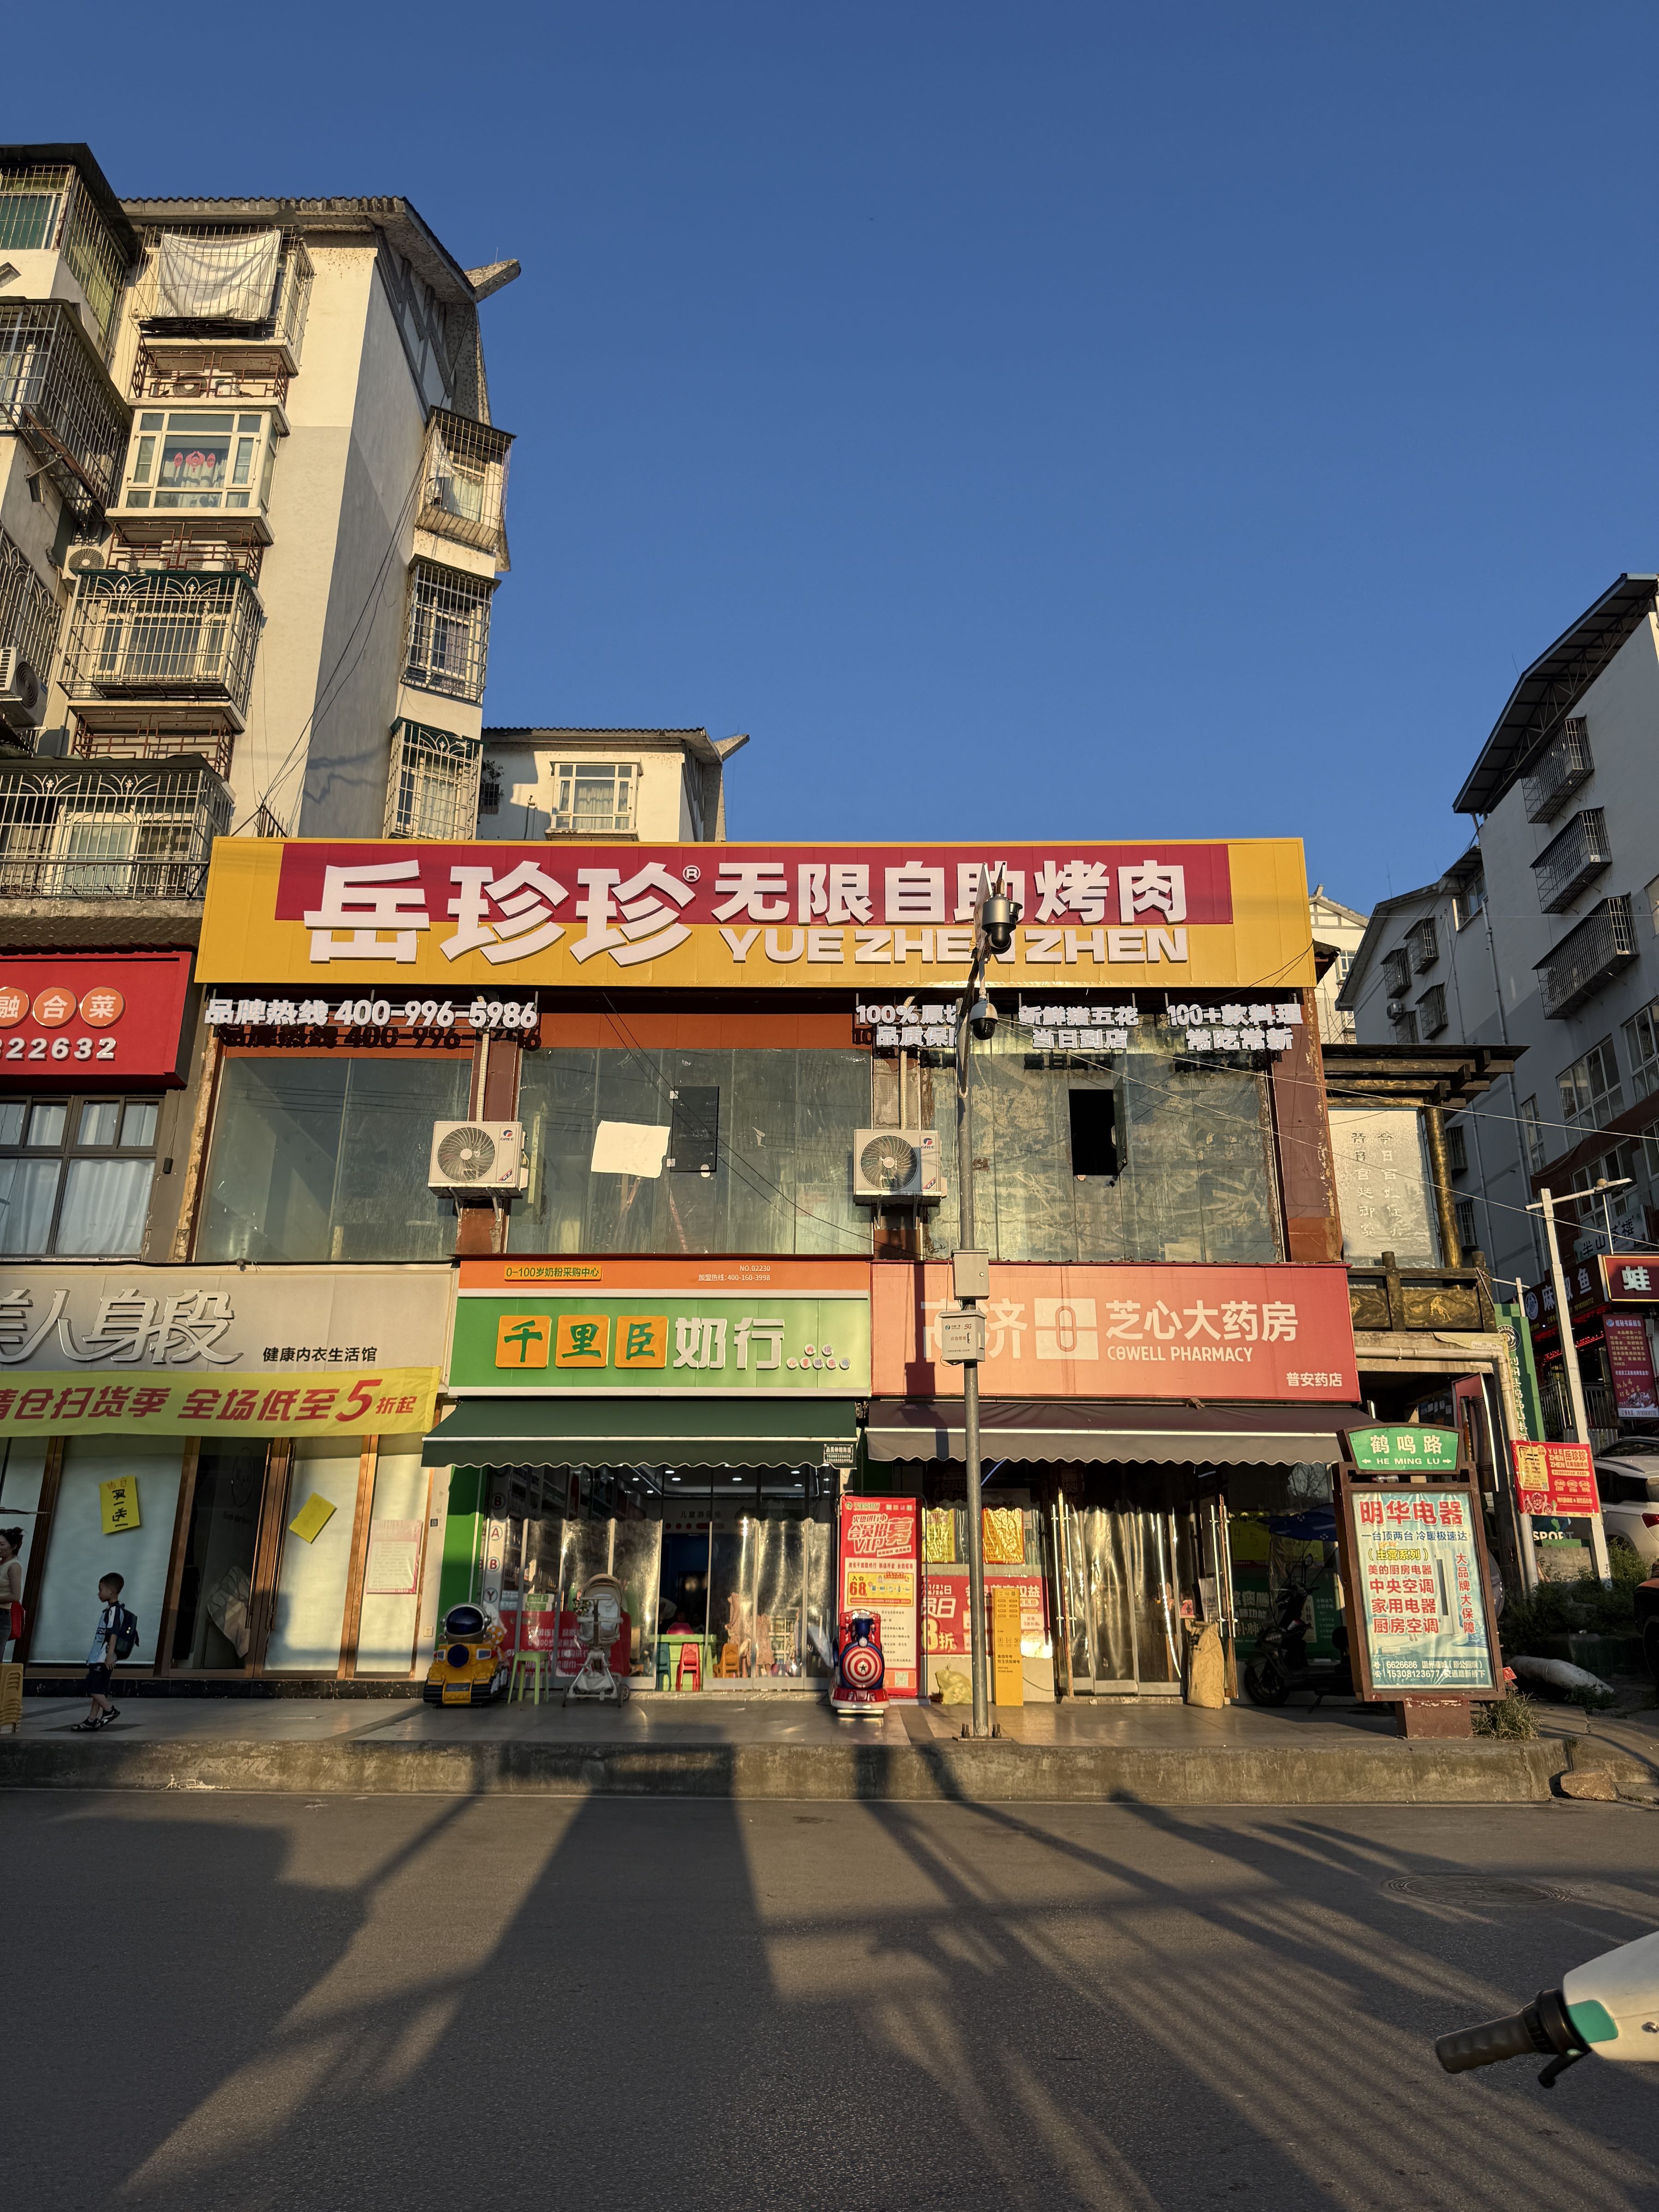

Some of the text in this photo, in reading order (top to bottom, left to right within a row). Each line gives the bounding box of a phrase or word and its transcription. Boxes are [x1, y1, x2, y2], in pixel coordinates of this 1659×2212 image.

[712, 860, 1187, 925] 无限自助烤肉
[304, 859, 696, 967] 岳珍珍
[720, 929, 843, 962] YUE
[1026, 929, 1188, 963] ZHEN
[205, 999, 538, 1029] 品牌热线 400-996-5986
[1018, 1006, 1139, 1026] 新鲜猪五花
[1167, 1004, 1303, 1026] 100+款料理
[877, 1026, 957, 1047] 品质保
[1033, 1028, 1128, 1049] 当日到店
[1186, 1027, 1294, 1051] 常吃常新
[0, 1037, 117, 1060] 22632
[506, 1267, 599, 1277] 0-100岁奶粉采购中心
[1106, 1300, 1299, 1343] 芝心大药房
[263, 1347, 378, 1363] 健康内衣生活馆
[1171, 1346, 1253, 1363] PHARMACY
[1286, 1372, 1342, 1388] 普安药店
[0, 1379, 418, 1422] 清仓扫货季 全场低至5折起
[1371, 1435, 1442, 1454] 鹤鸣路
[1565, 1450, 1586, 1461] 岳珍珍
[1359, 1500, 1464, 1526] 明华电器
[853, 1537, 885, 1553] VIP
[1362, 1531, 1468, 1541] 一台顶两台 冷暖极速达
[1368, 1565, 1432, 1576] 美的厨房电器
[1369, 1578, 1435, 1594] 中央空调
[1455, 1553, 1475, 1634] 大品牌大保障
[1371, 1598, 1436, 1614] 家用电器
[1373, 1618, 1439, 1634] 厨房空调
[1386, 1660, 1418, 1669] 6626686
